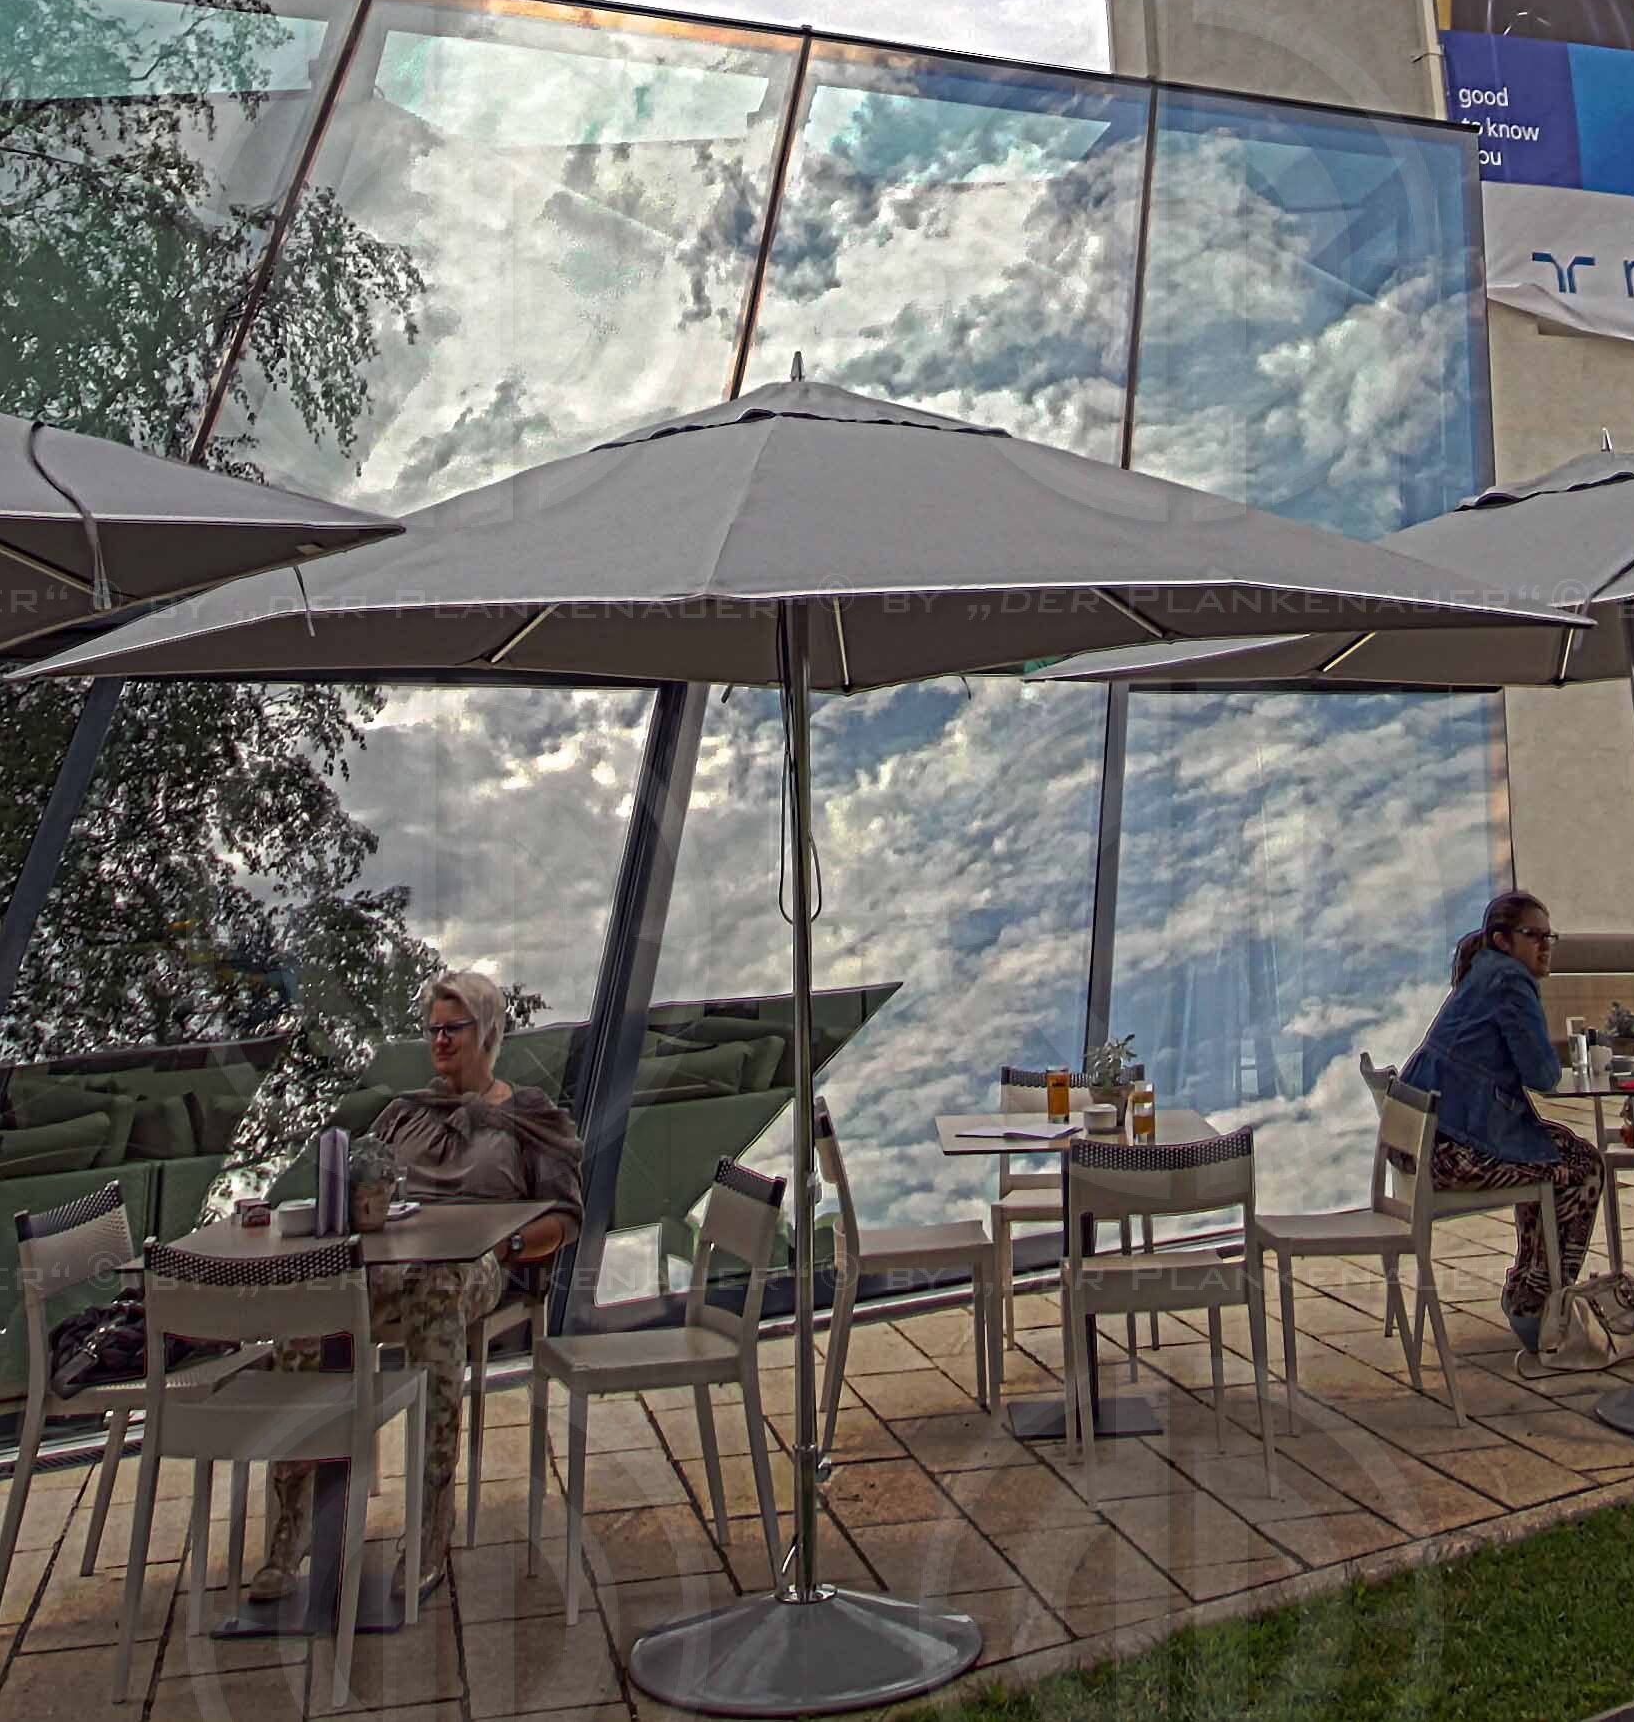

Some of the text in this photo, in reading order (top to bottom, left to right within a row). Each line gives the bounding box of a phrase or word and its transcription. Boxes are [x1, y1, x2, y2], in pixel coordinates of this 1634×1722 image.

[1458, 86, 1509, 108] good
[1486, 117, 1540, 142] know
[1479, 149, 1502, 166] ou
